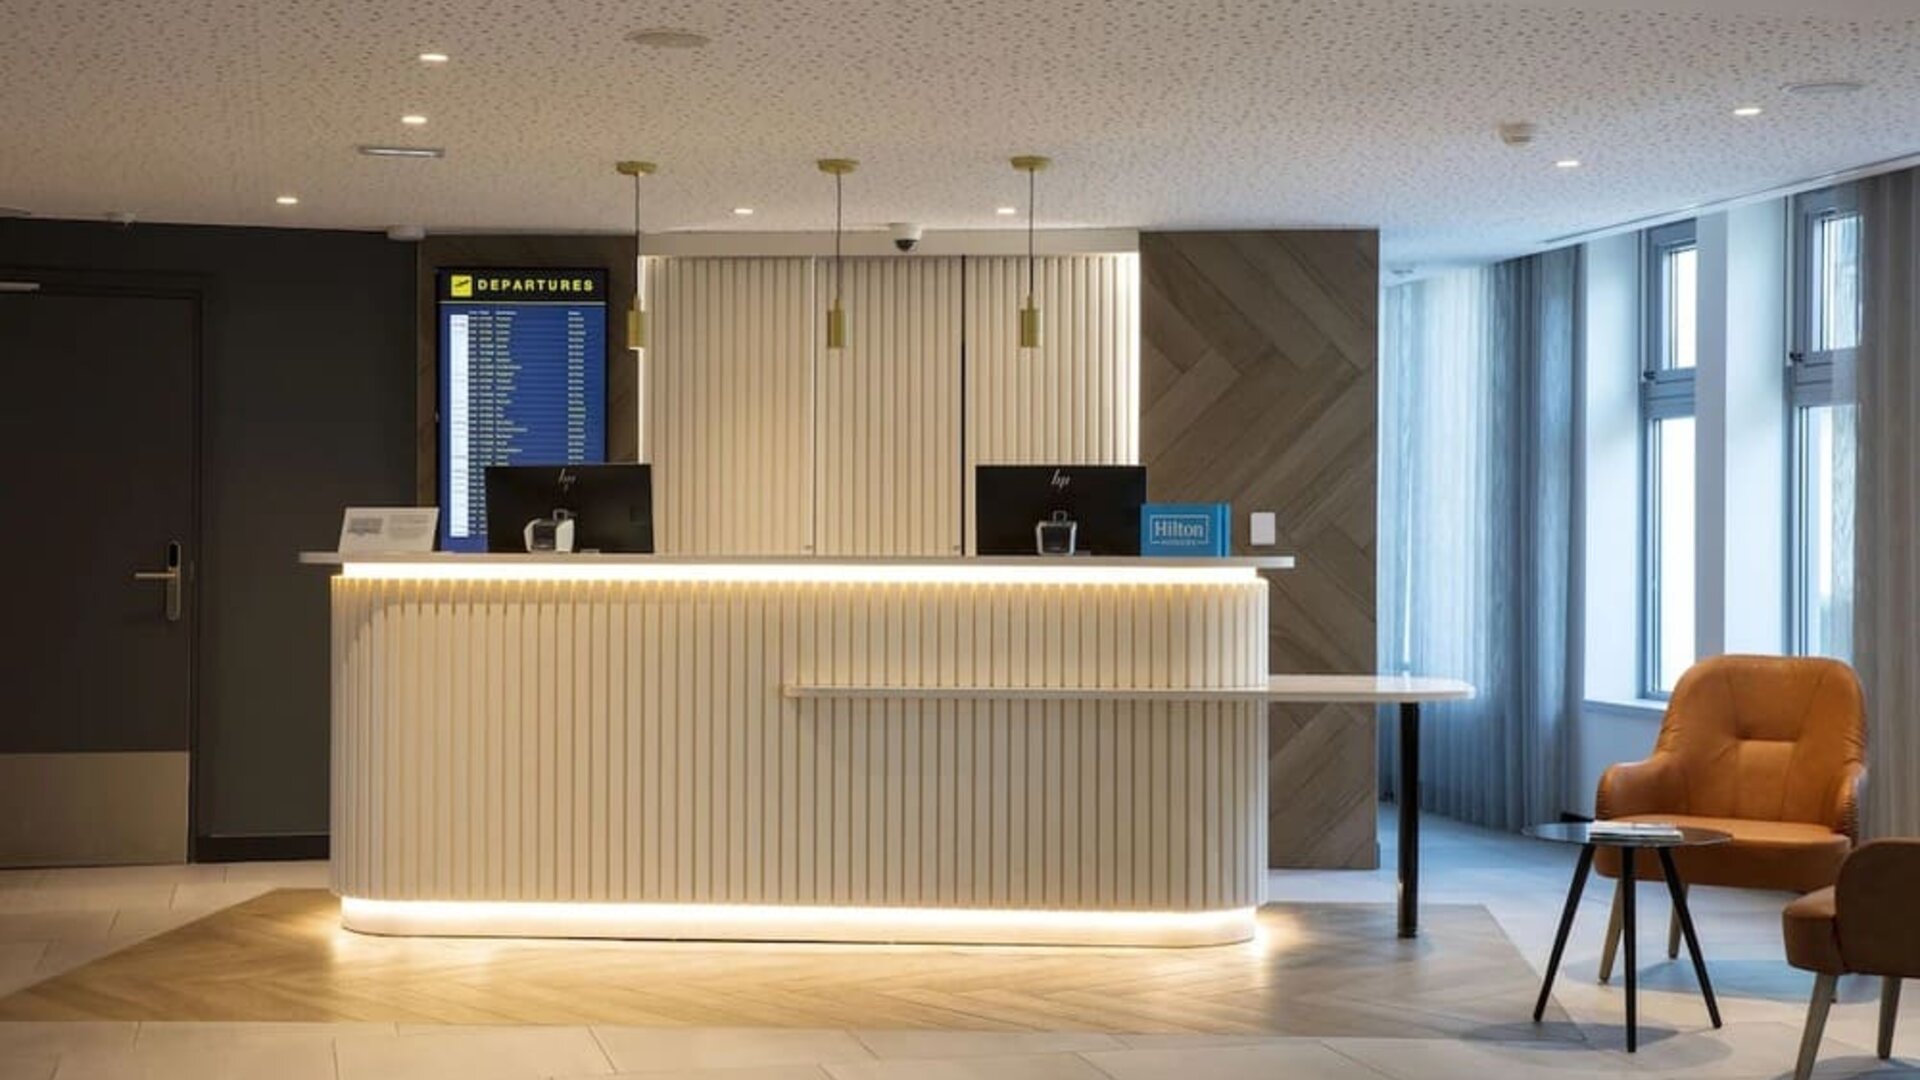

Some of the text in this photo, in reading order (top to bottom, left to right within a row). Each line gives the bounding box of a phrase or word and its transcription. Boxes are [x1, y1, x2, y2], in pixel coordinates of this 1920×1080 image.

[478, 279, 594, 291] DEPARTURES
[1051, 468, 1070, 488] hp
[1155, 520, 1203, 537] Hilton
